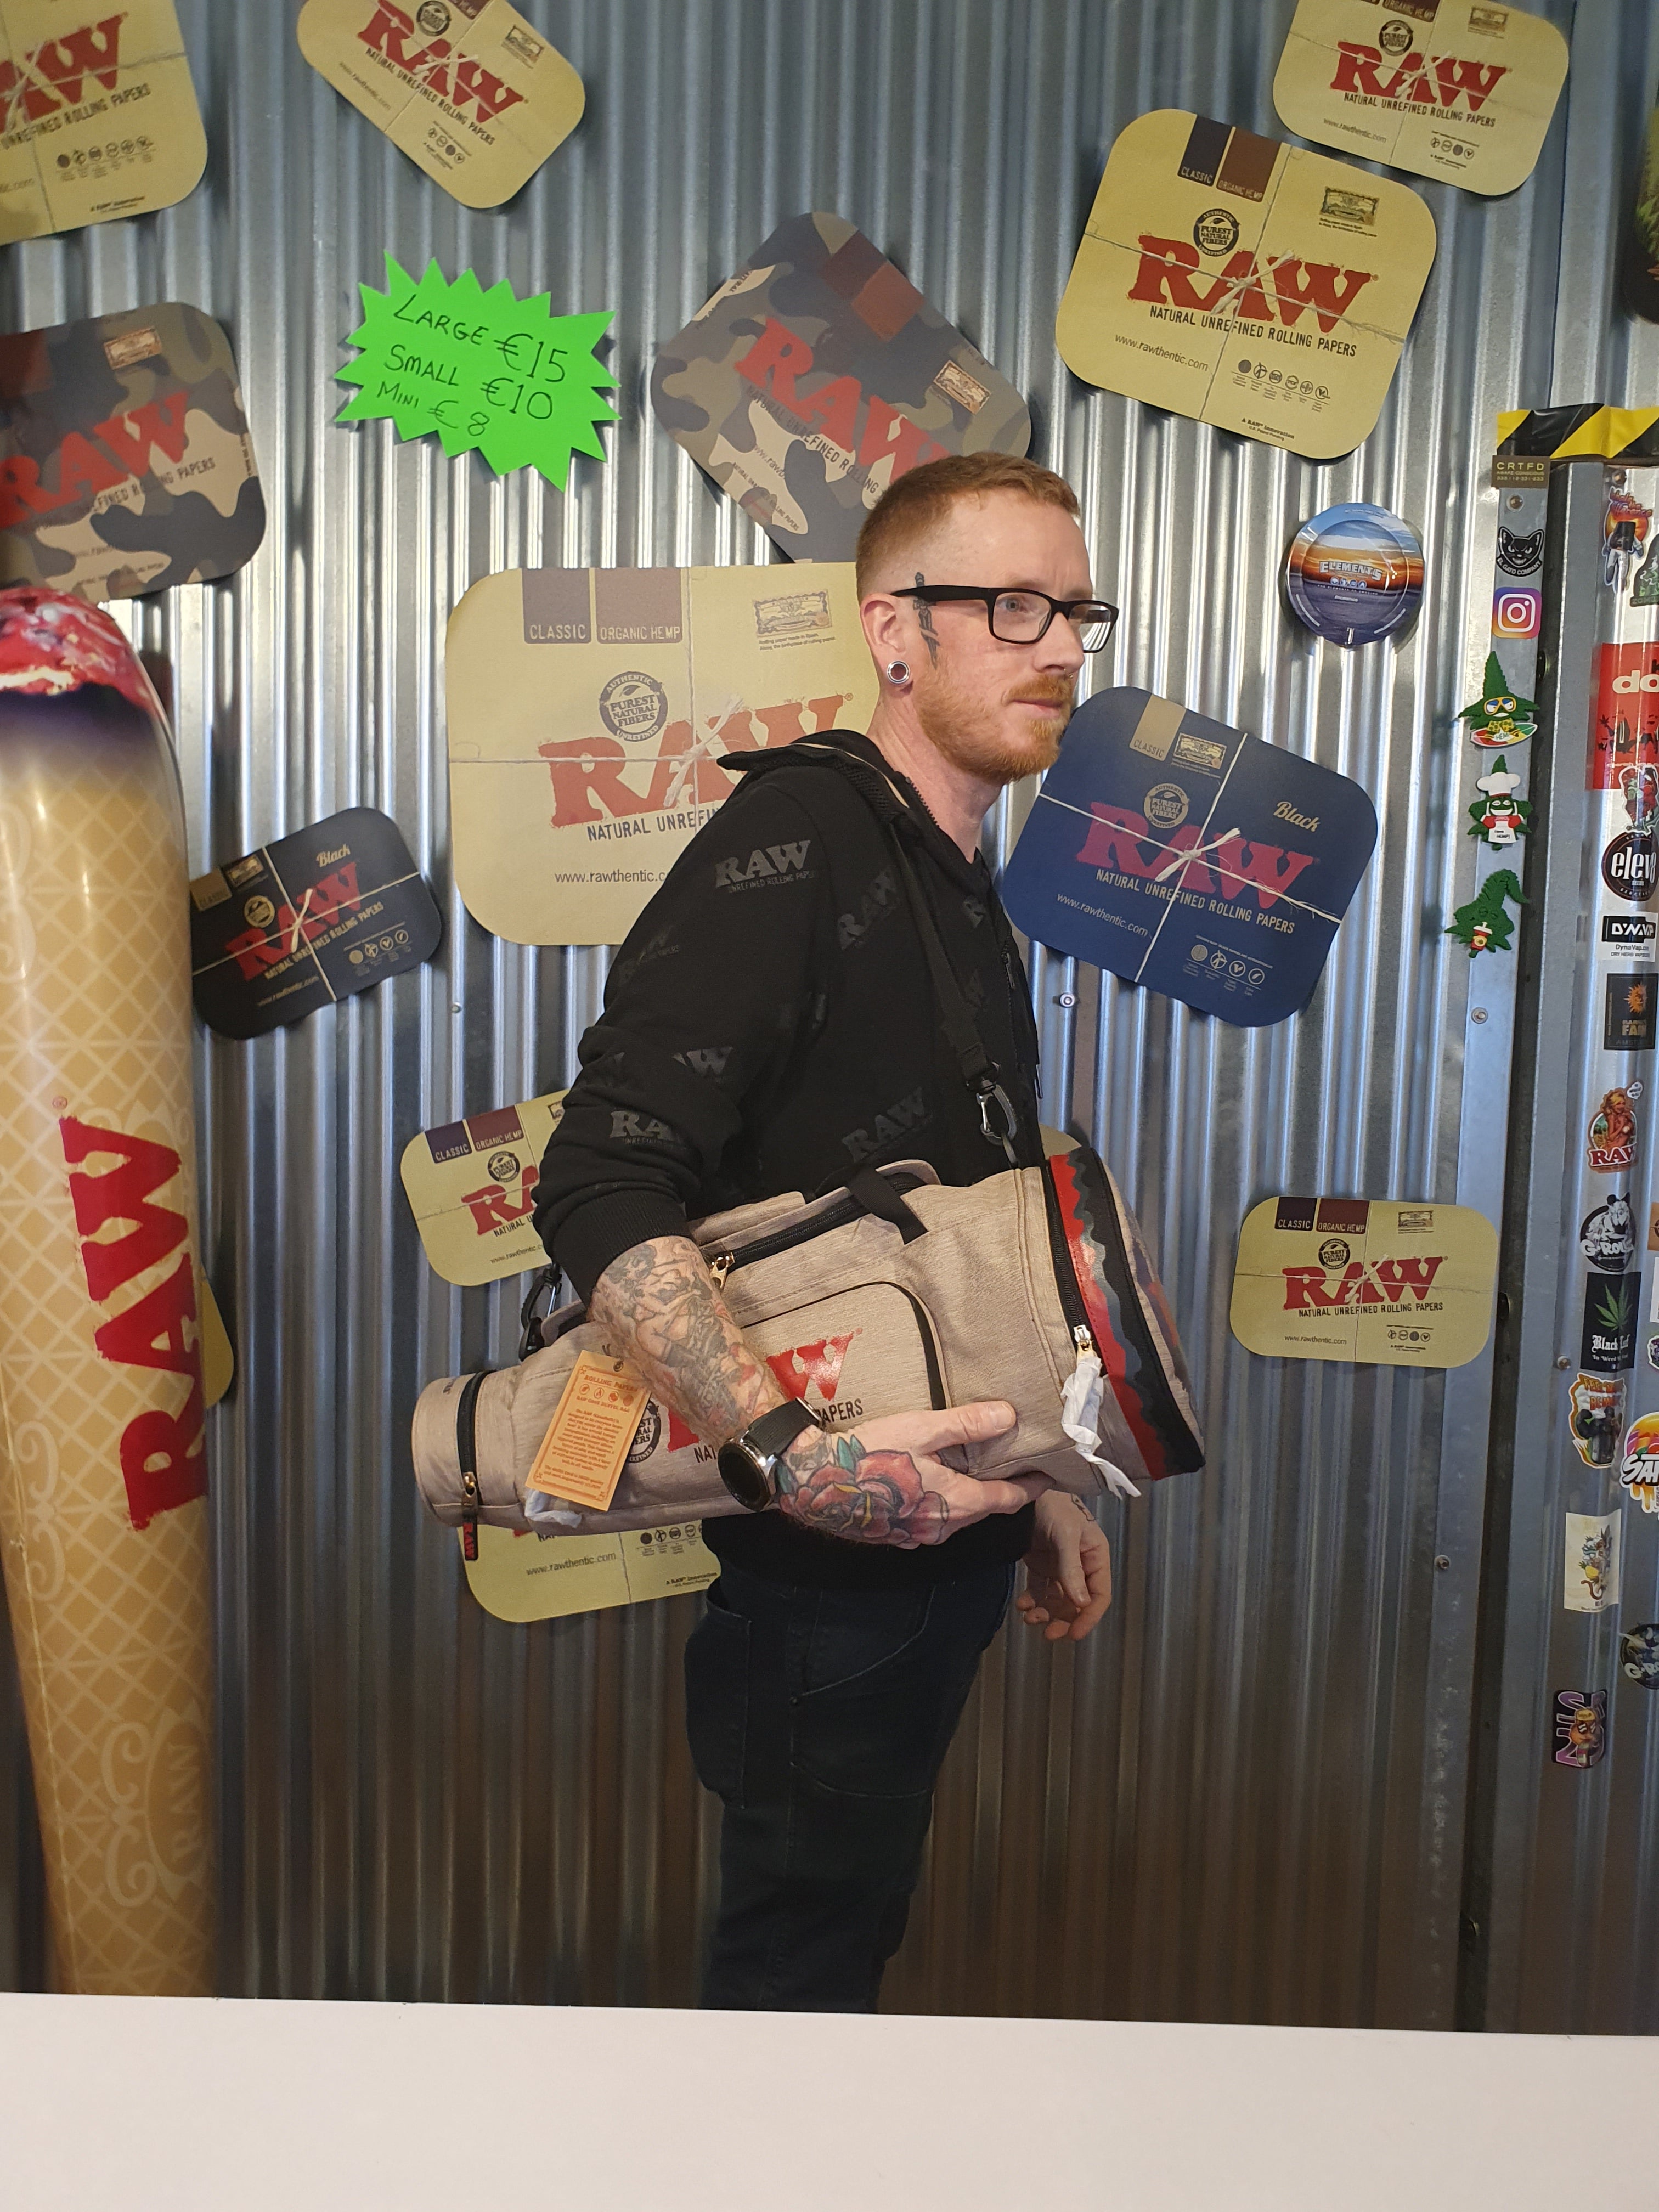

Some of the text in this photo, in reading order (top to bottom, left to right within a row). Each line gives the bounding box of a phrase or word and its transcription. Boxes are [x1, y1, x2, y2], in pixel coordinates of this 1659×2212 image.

[358, 0, 524, 123] RAW
[1330, 41, 1506, 111] RAW
[1344, 92, 1496, 128] NATURAL UNREFINED ROLLING PAPERS
[438, 99, 469, 125] ROLLING
[469, 121, 495, 145] PAPERS
[1181, 166, 1214, 184] CLASSIC
[1218, 180, 1263, 200] ORGANIC HEMP
[1200, 232, 1231, 240] NATURAL
[1201, 225, 1233, 235] PUREST
[1202, 238, 1228, 246] FIBERS
[1128, 234, 1372, 334] RAW
[393, 294, 568, 383] LARGE €15
[1150, 305, 1358, 358] NATURAL UNREFINED ROLLING PAPERS
[1114, 333, 1209, 372] www.rawthentic.com
[383, 344, 553, 420] SMALL €10
[178, 456, 216, 481] PAPERS
[839, 459, 879, 494] ROLLING
[1496, 462, 1544, 471] CRTFD
[1319, 561, 1385, 581] ELEMENTS
[1517, 560, 1541, 575] COMPANY
[528, 624, 587, 641] CLASSIC
[600, 625, 681, 641] ORGANIC HEMP
[606, 674, 653, 693] AUTHENTIC
[610, 694, 655, 712] PUREST
[613, 704, 657, 719] NATURAL
[617, 712, 656, 727] FIBERS
[617, 725, 658, 740] UNREFINED
[1133, 739, 1165, 758] CLASSIC
[538, 695, 845, 827] RAW
[1273, 800, 1321, 832] Black
[586, 817, 651, 842] NATURAL
[315, 843, 351, 868] Black
[714, 839, 811, 889] RAW
[1076, 802, 1316, 910] RAW
[1611, 847, 1657, 883] elev8
[358, 901, 385, 923] PAPERS
[1096, 869, 1295, 935] NATURAL UNREFINED ROLLING PAPERS
[225, 861, 362, 981] RAW
[1056, 893, 1149, 938] www.rawthentic.com
[475, 1129, 522, 1150] ORGANIC HEMP
[435, 1144, 470, 1161] CLASSIC
[493, 1215, 526, 1237] NATURAL
[1277, 1218, 1311, 1230] CLASSIC
[1318, 1222, 1365, 1233] ORGANIC HEMP
[1282, 1256, 1443, 1310] RAW
[1298, 1302, 1443, 1318] NATURAL UNREFINED ROLLING PAPERS
[58, 1115, 210, 1531] RAW
[1284, 1334, 1347, 1346] www.rawthentic.com
[1591, 1334, 1618, 1353] Black
[526, 1551, 617, 1576] www.rawthentic.com
